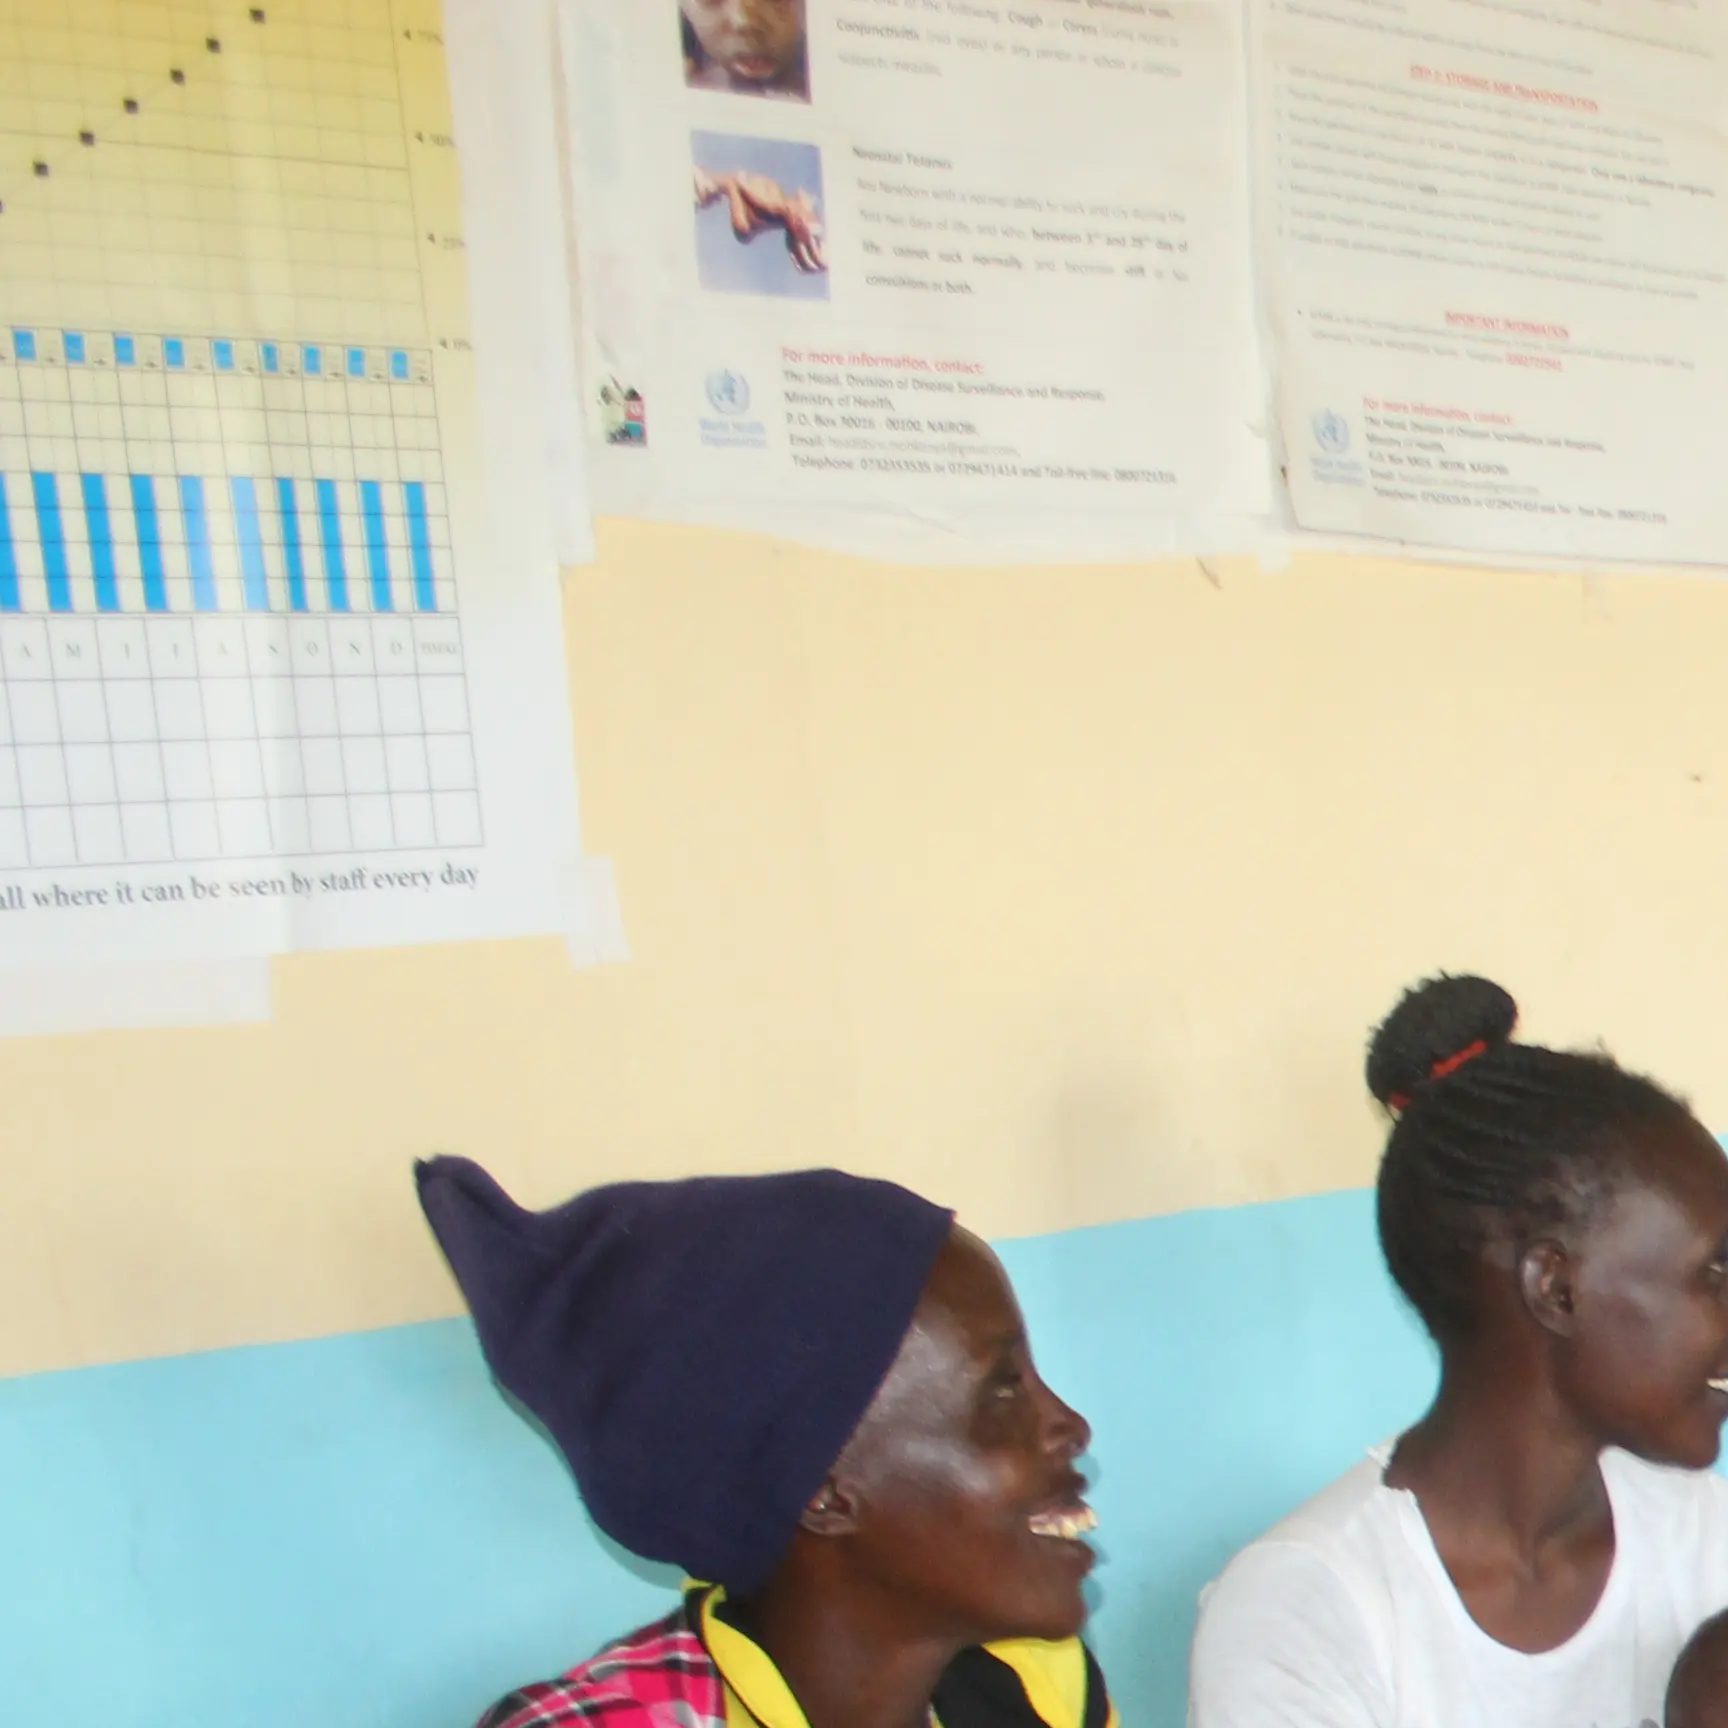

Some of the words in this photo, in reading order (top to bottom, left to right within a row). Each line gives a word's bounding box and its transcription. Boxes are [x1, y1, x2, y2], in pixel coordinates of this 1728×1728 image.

[1031, 226, 1082, 244] between
[782, 347, 802, 362] For
[808, 352, 844, 365] more
[783, 369, 806, 384] The
[847, 373, 893, 389] Division
[896, 378, 908, 390] of
[911, 379, 954, 393] Disease
[957, 381, 1023, 398] Surveillance
[1027, 387, 1048, 400] and
[784, 391, 833, 408] Ministry
[838, 394, 850, 407] of
[33, 882, 108, 910] where
[116, 879, 135, 905] it
[141, 884, 185, 904] can
[189, 874, 221, 900] be
[229, 879, 286, 899] seen
[290, 870, 314, 900] by
[320, 867, 369, 893] staff
[374, 869, 434, 895] every
[441, 863, 480, 891] day
